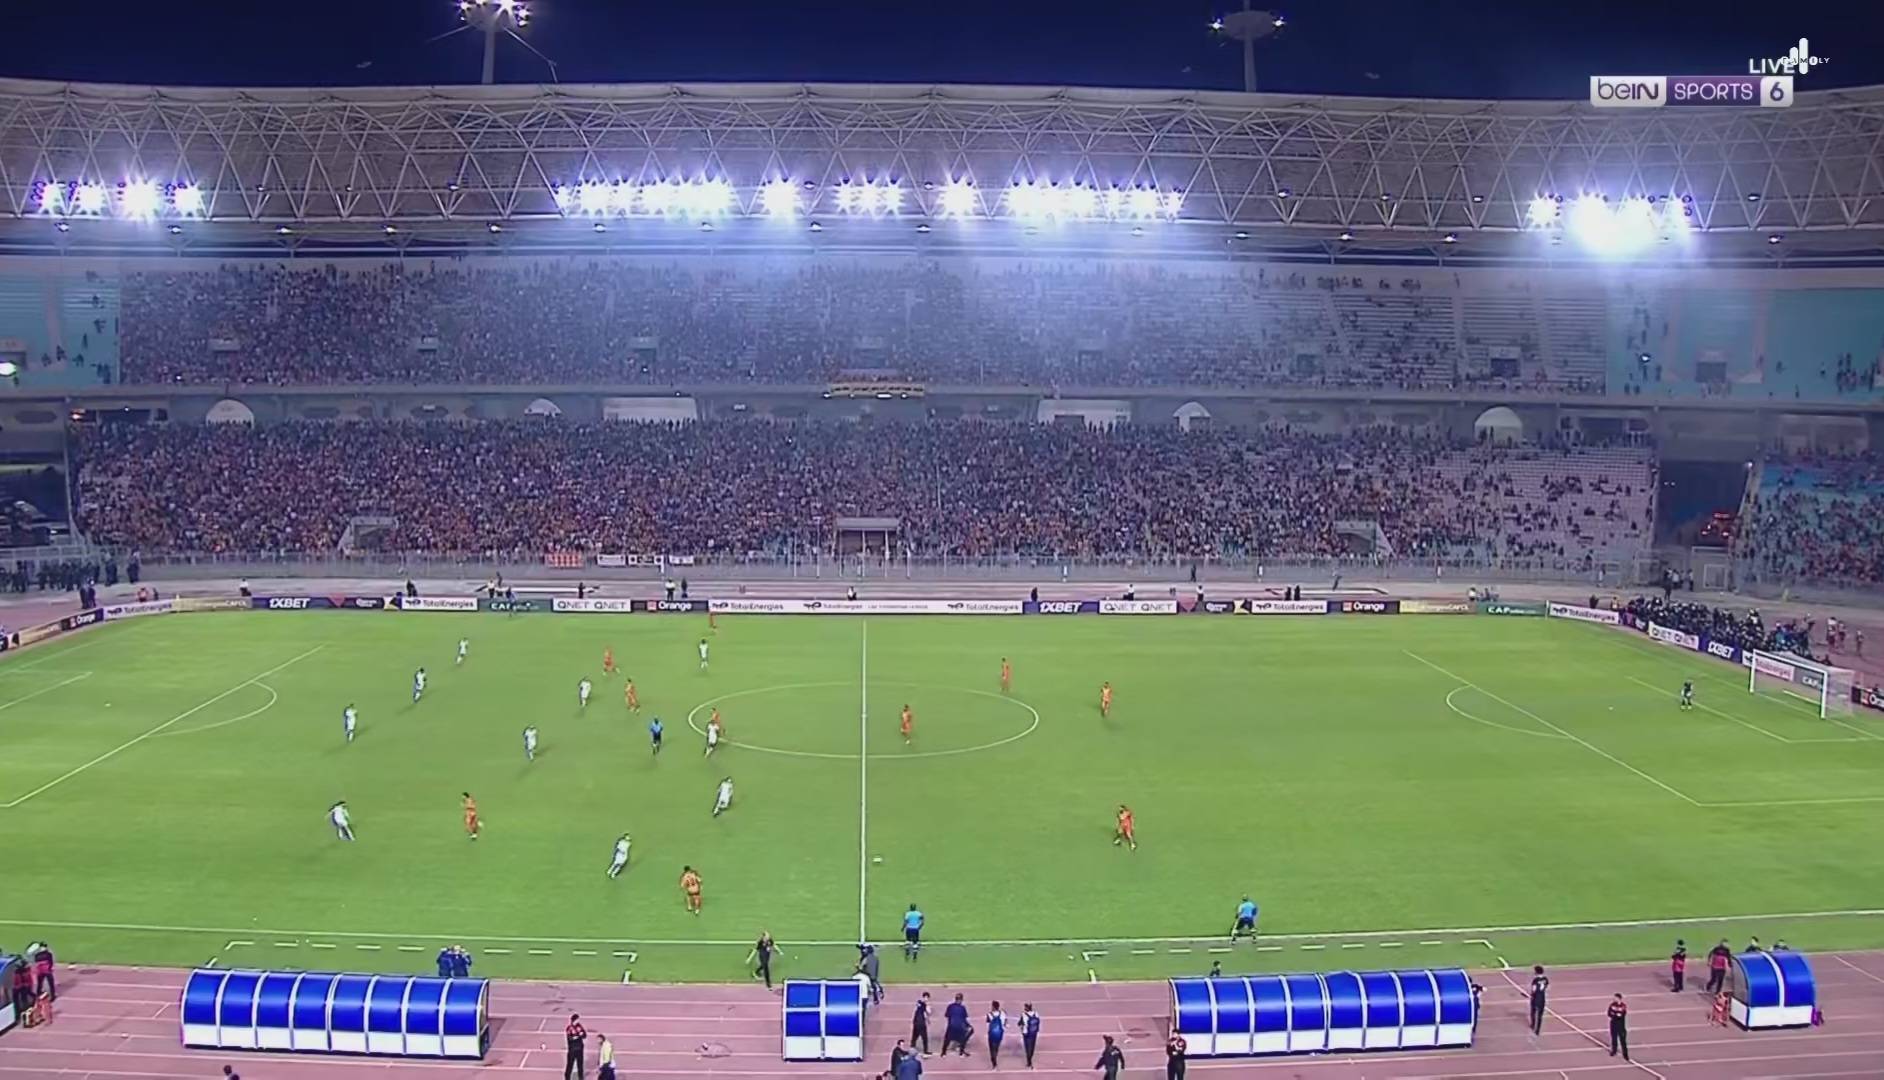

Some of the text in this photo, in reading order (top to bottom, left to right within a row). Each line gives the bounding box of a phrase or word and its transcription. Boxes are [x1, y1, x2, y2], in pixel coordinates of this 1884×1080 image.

[269, 598, 311, 609] 1XBET
[557, 600, 627, 610] QNET QNET
[658, 601, 692, 612] Orange
[731, 602, 784, 611] TotalEnergies
[1039, 602, 1082, 613] 1XBET
[1104, 602, 1173, 612] QNET QNET
[1353, 602, 1385, 613] Orange
